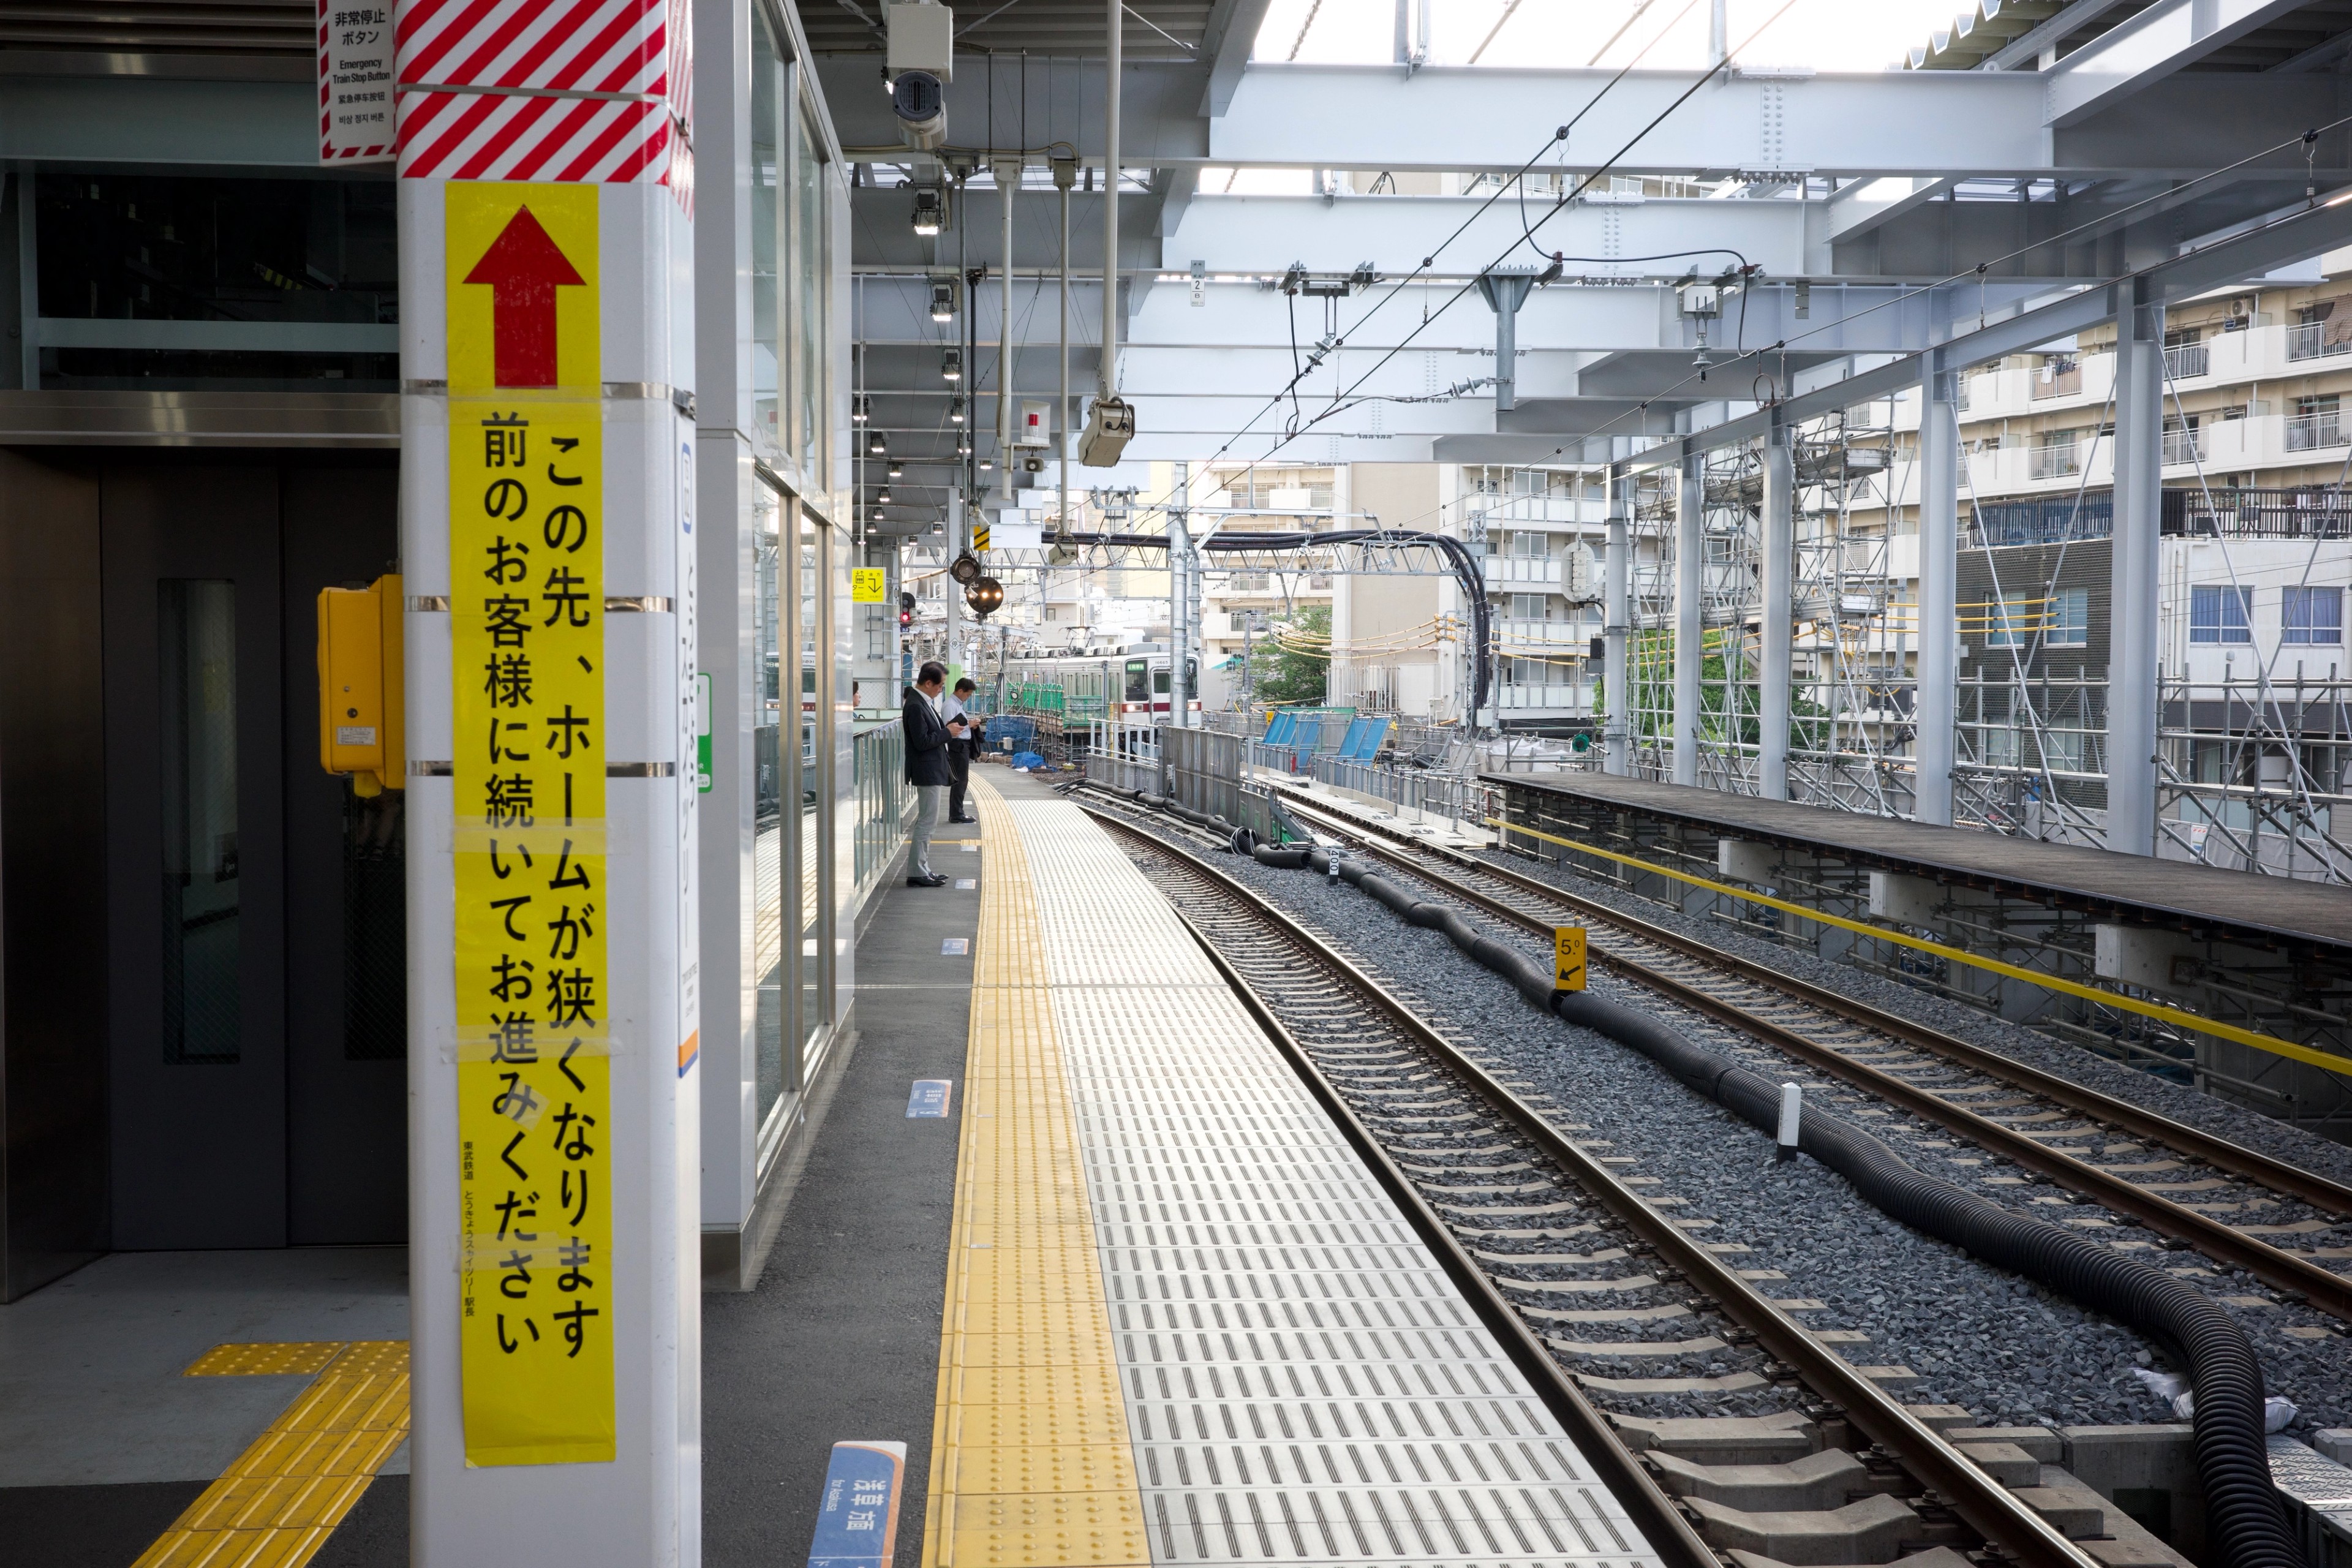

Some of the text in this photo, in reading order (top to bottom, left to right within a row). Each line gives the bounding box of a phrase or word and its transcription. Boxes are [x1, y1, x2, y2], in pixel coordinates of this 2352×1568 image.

[335, 8, 386, 27] 非常停止
[342, 31, 379, 46] ボタン
[340, 59, 382, 70] Emergency
[333, 72, 390, 85] Train Stop Button
[339, 115, 353, 125] 비상
[371, 113, 385, 123] 버튼
[1195, 281, 1200, 290] 2
[1330, 850, 1339, 871] 400
[481, 412, 540, 1355] 前のお客様に続いてお進みください
[543, 436, 599, 1358] この先、ホームが狭くなります
[463, 1141, 473, 1180] 東武鉄道
[826, 1479, 845, 1512] for Asakusa
[846, 1479, 887, 1531] 浅草方面
